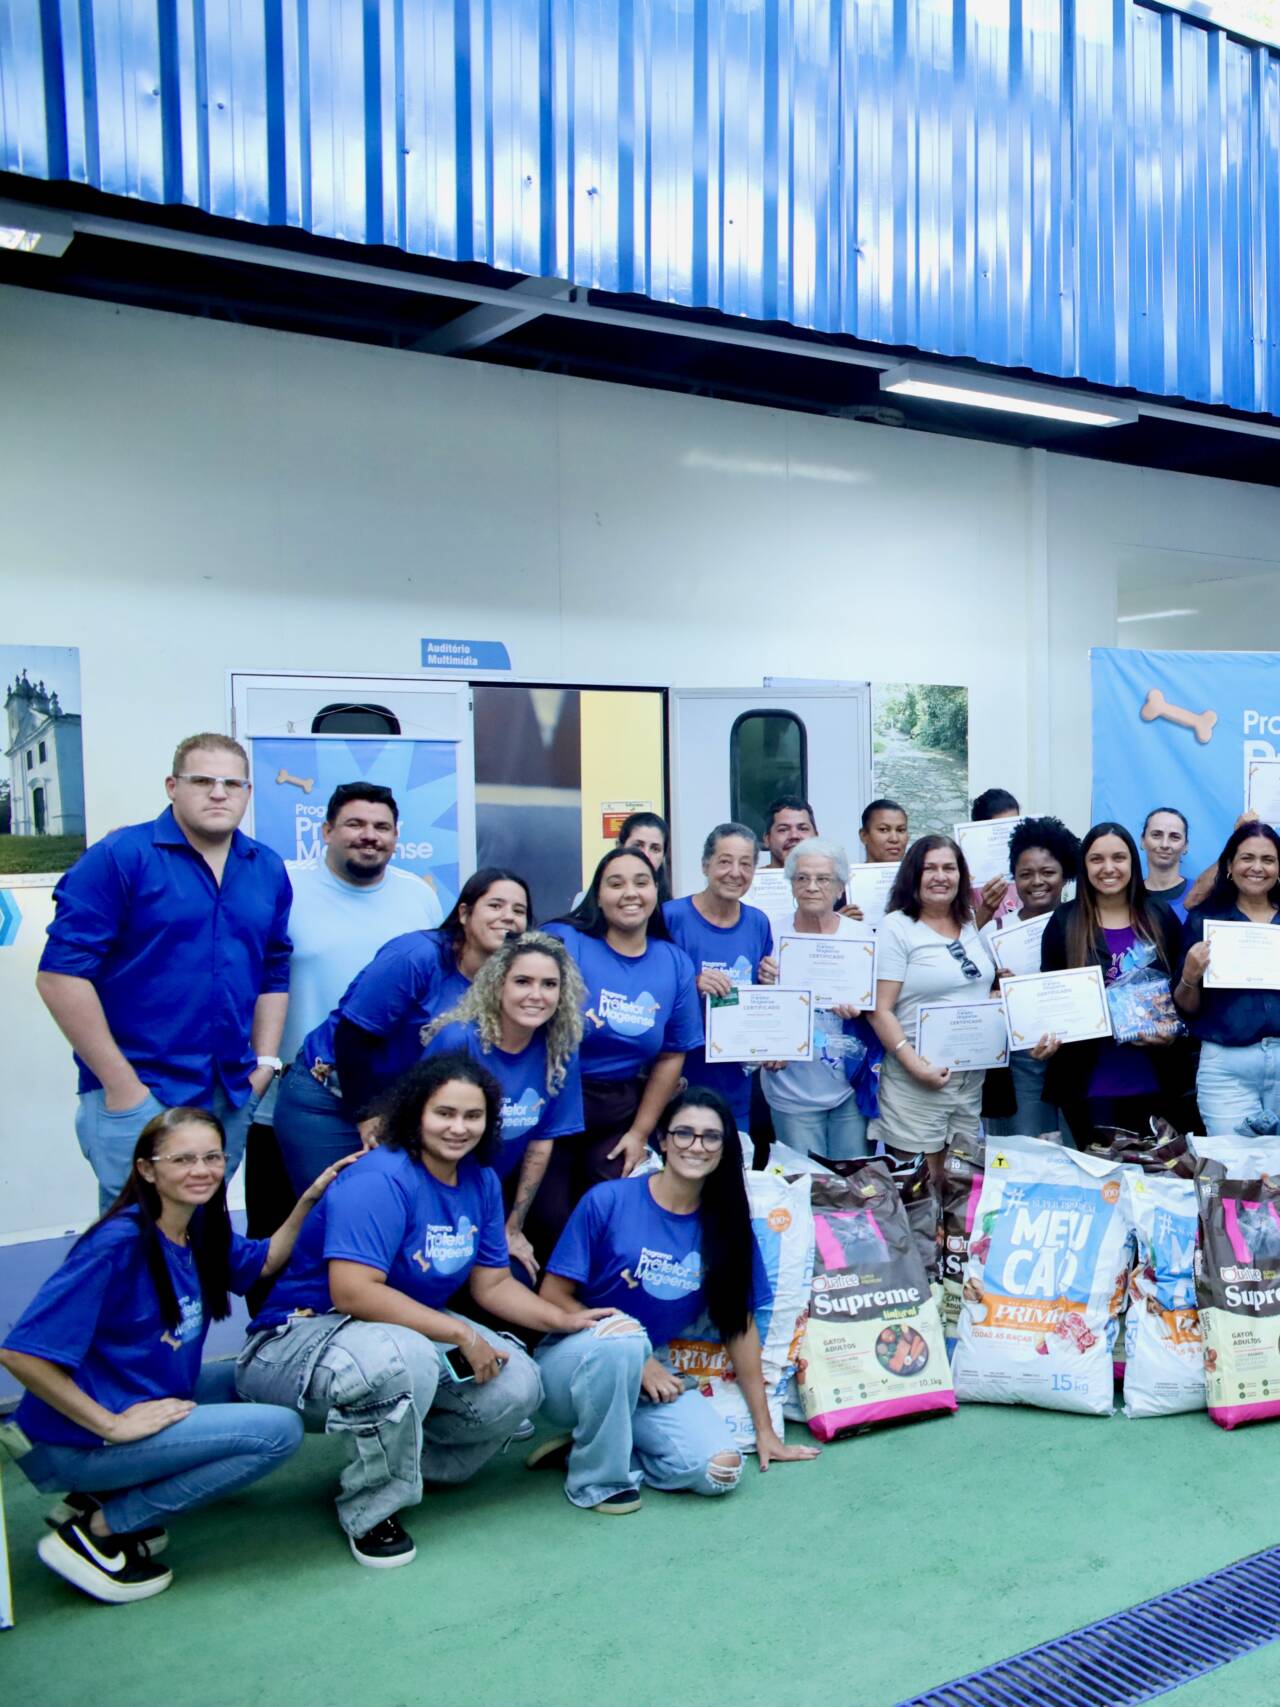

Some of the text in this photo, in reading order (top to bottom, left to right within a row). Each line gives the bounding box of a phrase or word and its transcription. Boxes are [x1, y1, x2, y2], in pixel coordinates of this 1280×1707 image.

[427, 643, 470, 654] Auditório
[427, 655, 479, 666] Multimídia
[1010, 1207, 1094, 1251] MEU
[639, 1254, 692, 1277] Protetor
[1002, 1245, 1078, 1297] CÃO
[634, 1267, 701, 1291] Mageense
[814, 1286, 921, 1316] Supreme
[882, 1306, 918, 1321] Natural
[823, 1337, 847, 1346] GATOS
[1232, 1330, 1254, 1339] GATOS
[1232, 1337, 1262, 1347] ADULTOS
[824, 1343, 857, 1354] ADULTOS
[1051, 1373, 1073, 1392] 15
[1074, 1380, 1089, 1393] kg
